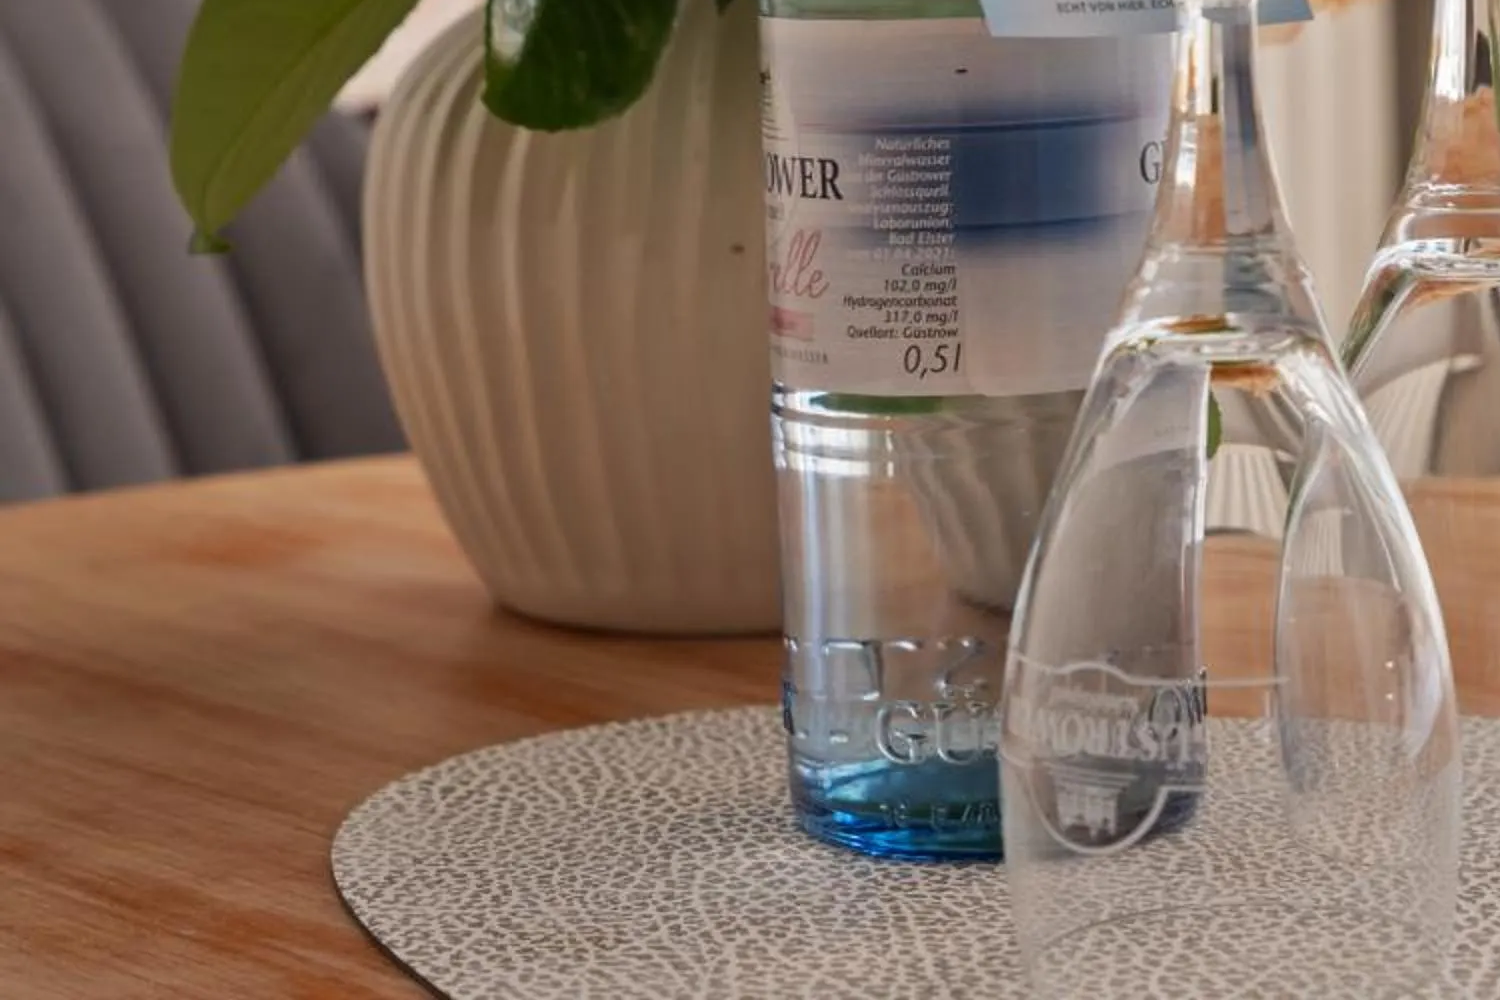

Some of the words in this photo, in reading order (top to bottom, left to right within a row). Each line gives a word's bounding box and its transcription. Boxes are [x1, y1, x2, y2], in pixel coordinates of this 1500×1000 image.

[1089, 0, 1115, 13] VON
[901, 263, 956, 277] Calcium
[842, 295, 958, 311] Hydrogencarbonat
